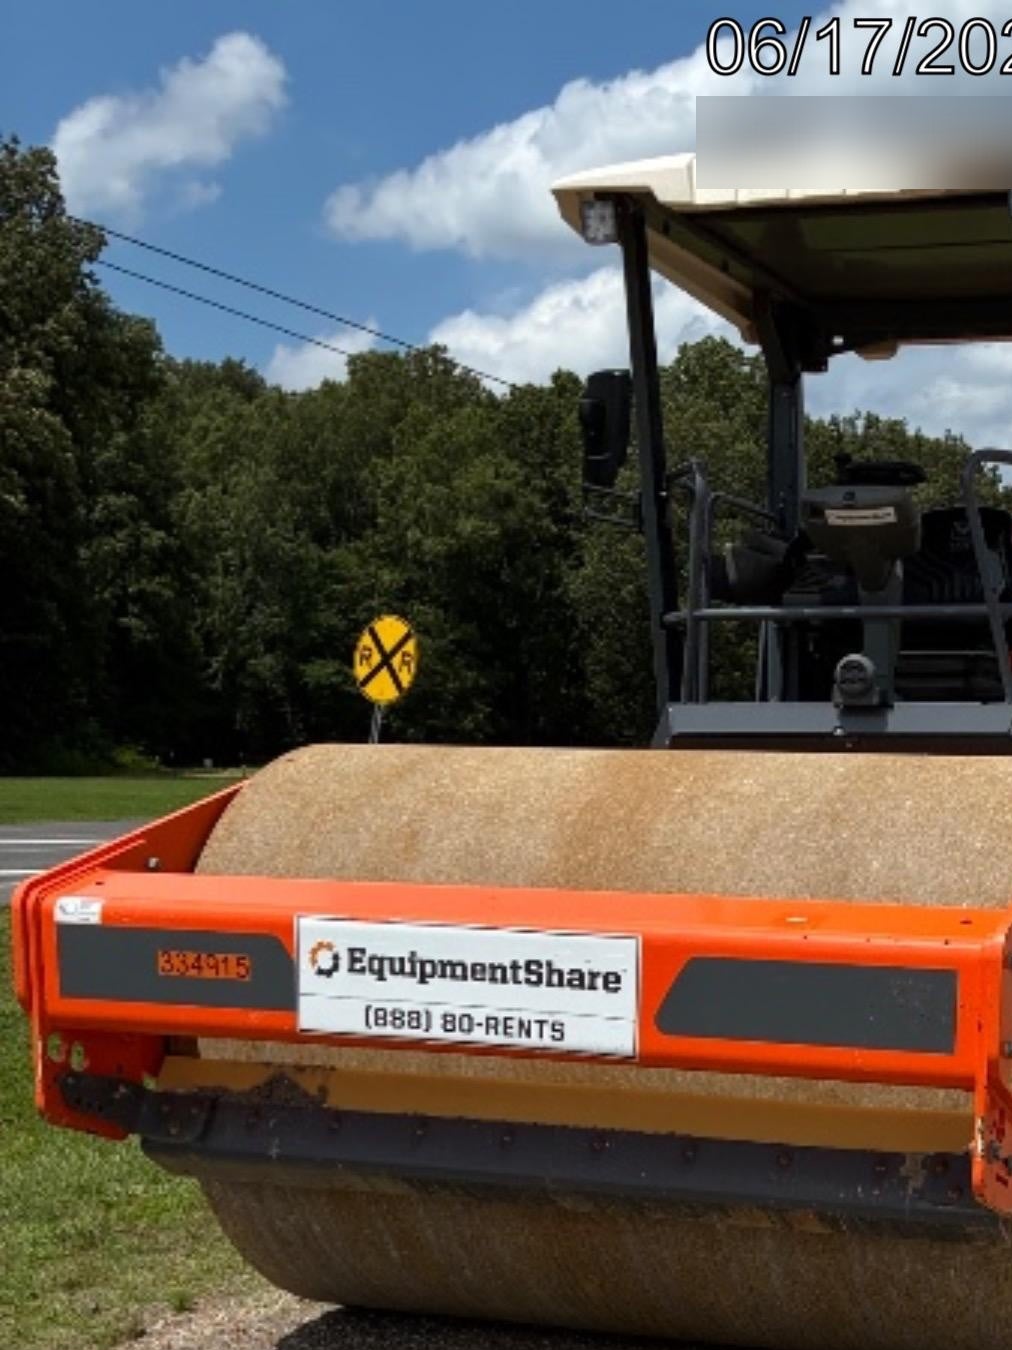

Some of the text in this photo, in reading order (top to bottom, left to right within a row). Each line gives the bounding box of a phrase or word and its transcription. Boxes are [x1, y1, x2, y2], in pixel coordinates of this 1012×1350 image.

[160, 951, 250, 980] 334915
[347, 947, 622, 993] EquipmentShare
[364, 1004, 565, 1042] (888) 80-RENTS
